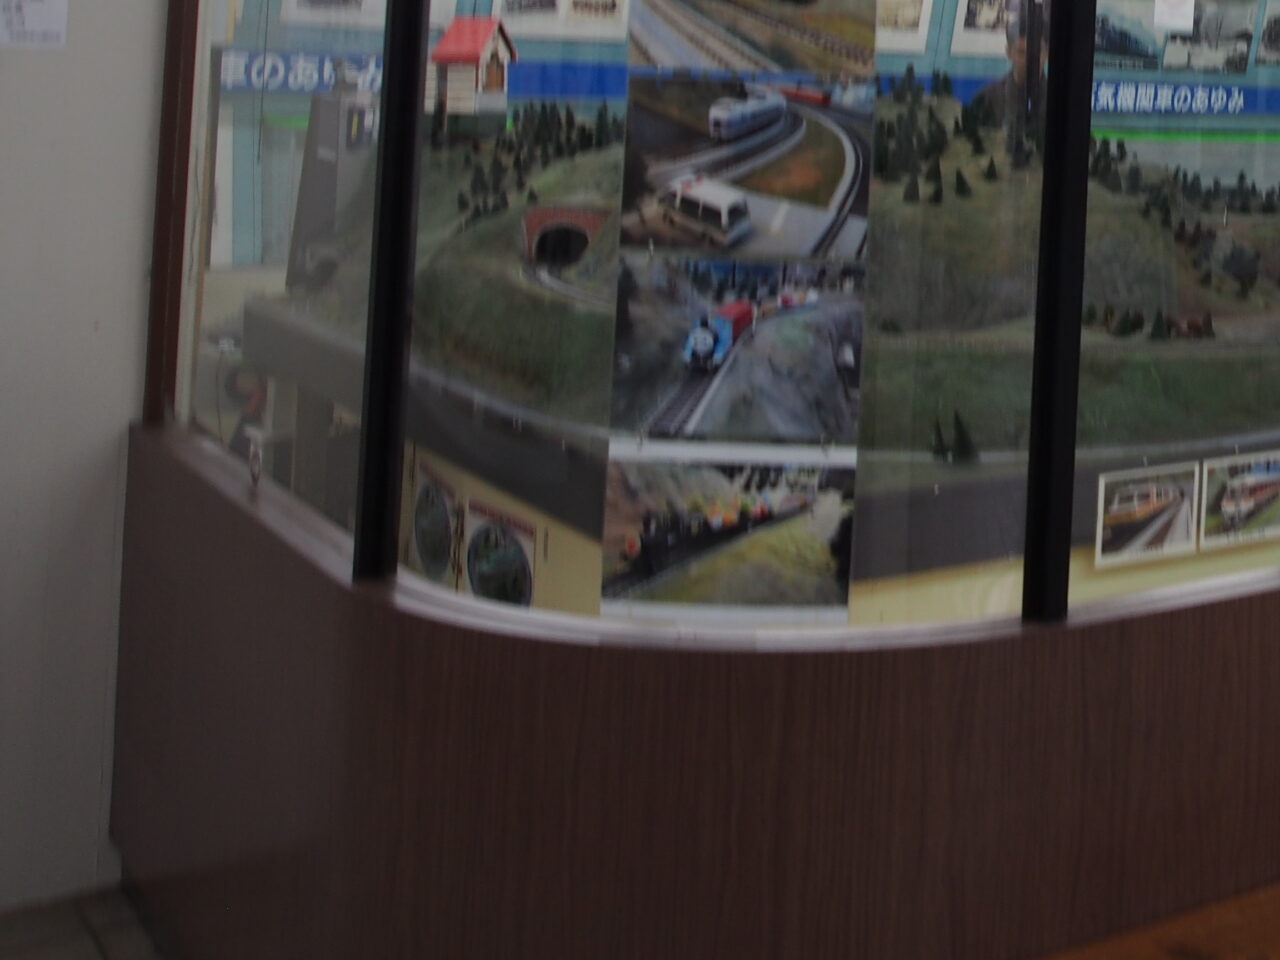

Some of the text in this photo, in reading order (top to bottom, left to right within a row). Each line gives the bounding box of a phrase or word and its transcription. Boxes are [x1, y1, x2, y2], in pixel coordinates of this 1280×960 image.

[1092, 81, 1244, 114] 気機関車のあゆみ
